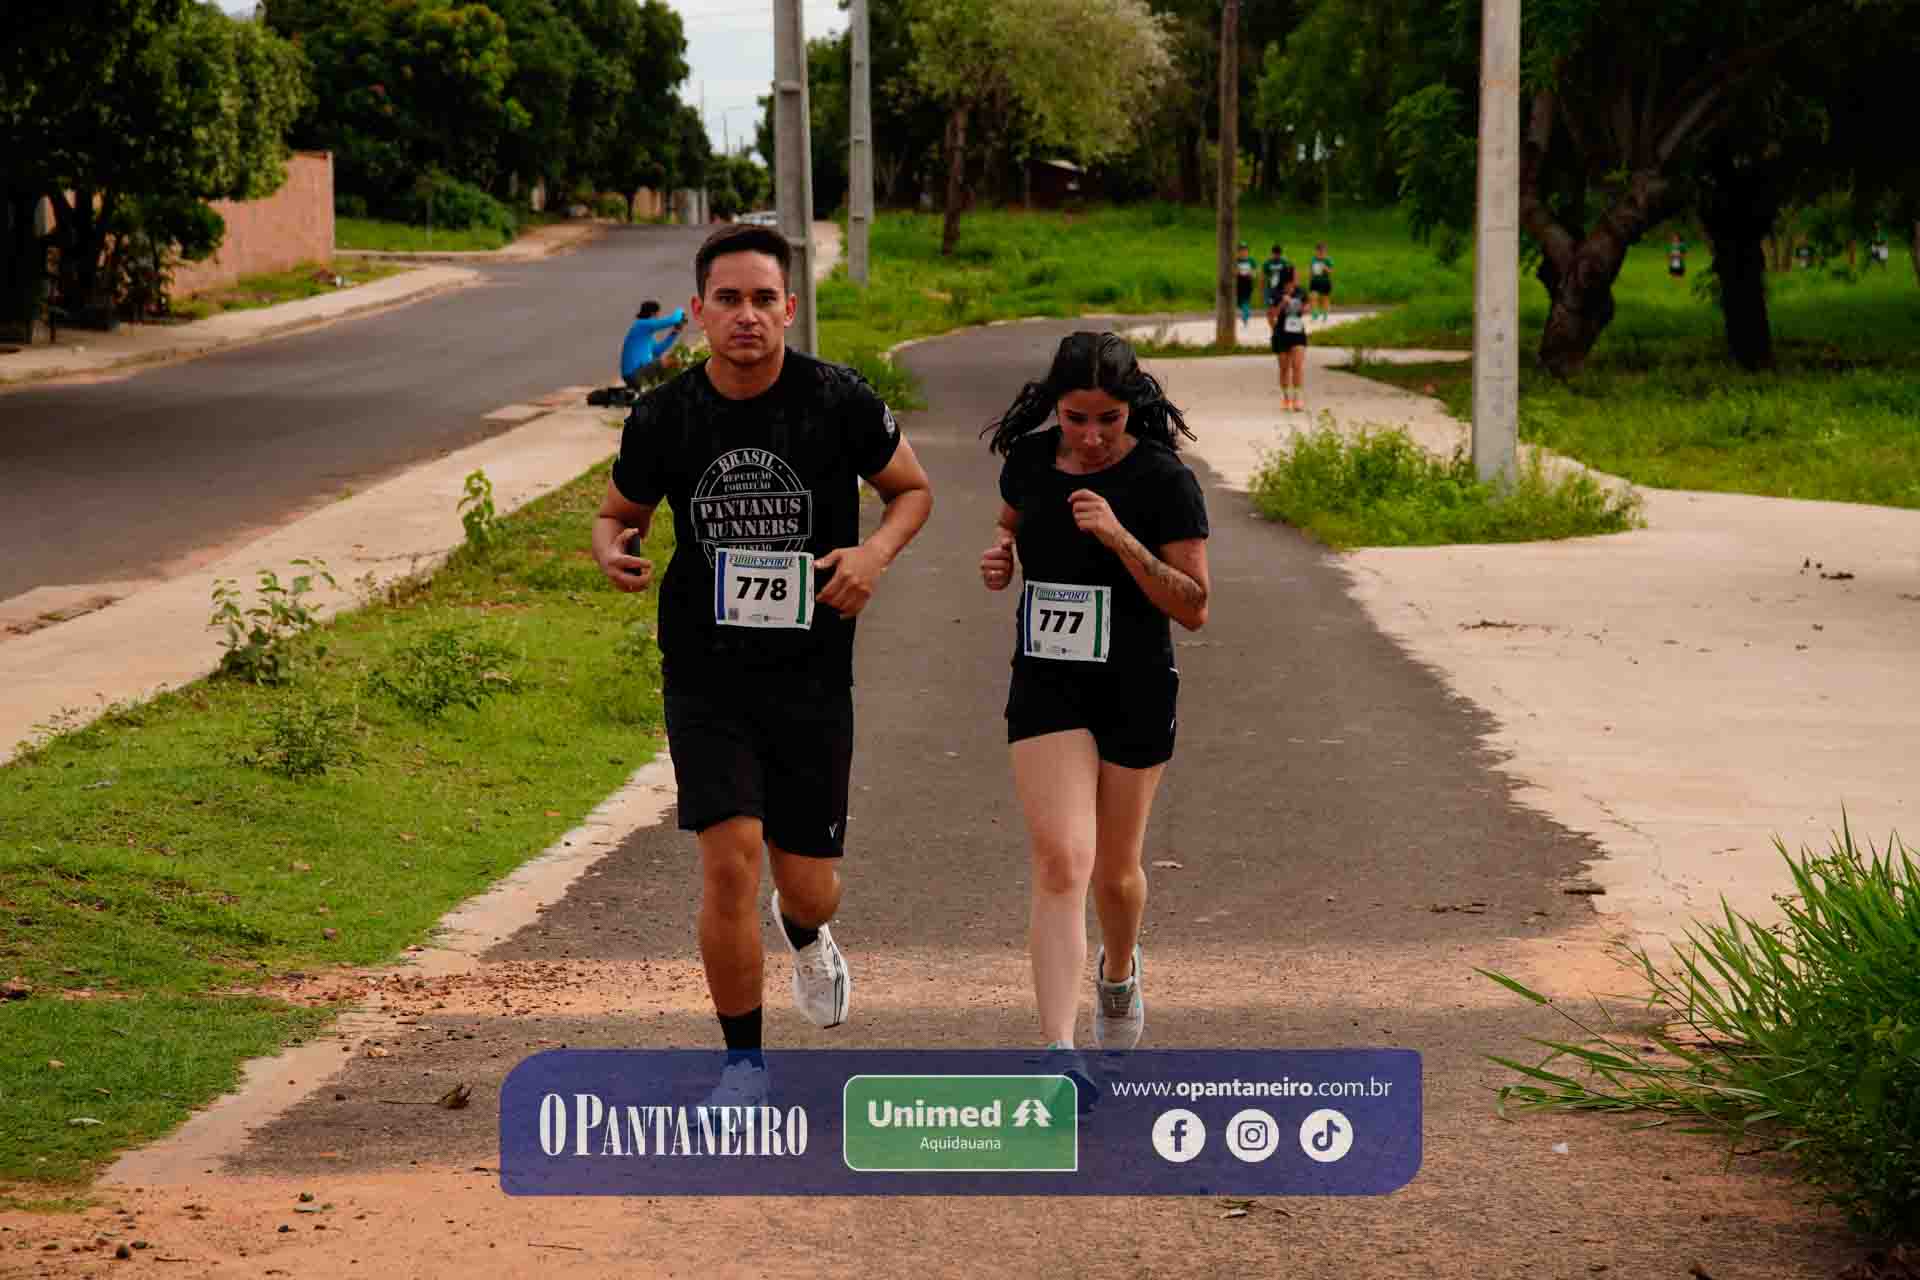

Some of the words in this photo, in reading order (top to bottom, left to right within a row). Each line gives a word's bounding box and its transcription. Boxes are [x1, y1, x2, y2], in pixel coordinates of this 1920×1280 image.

[718, 450, 775, 473] BRASIL
[701, 498, 801, 519] PANTANUS
[706, 518, 799, 538] RUNNERS
[736, 575, 787, 601] 778
[1039, 609, 1084, 634] 777
